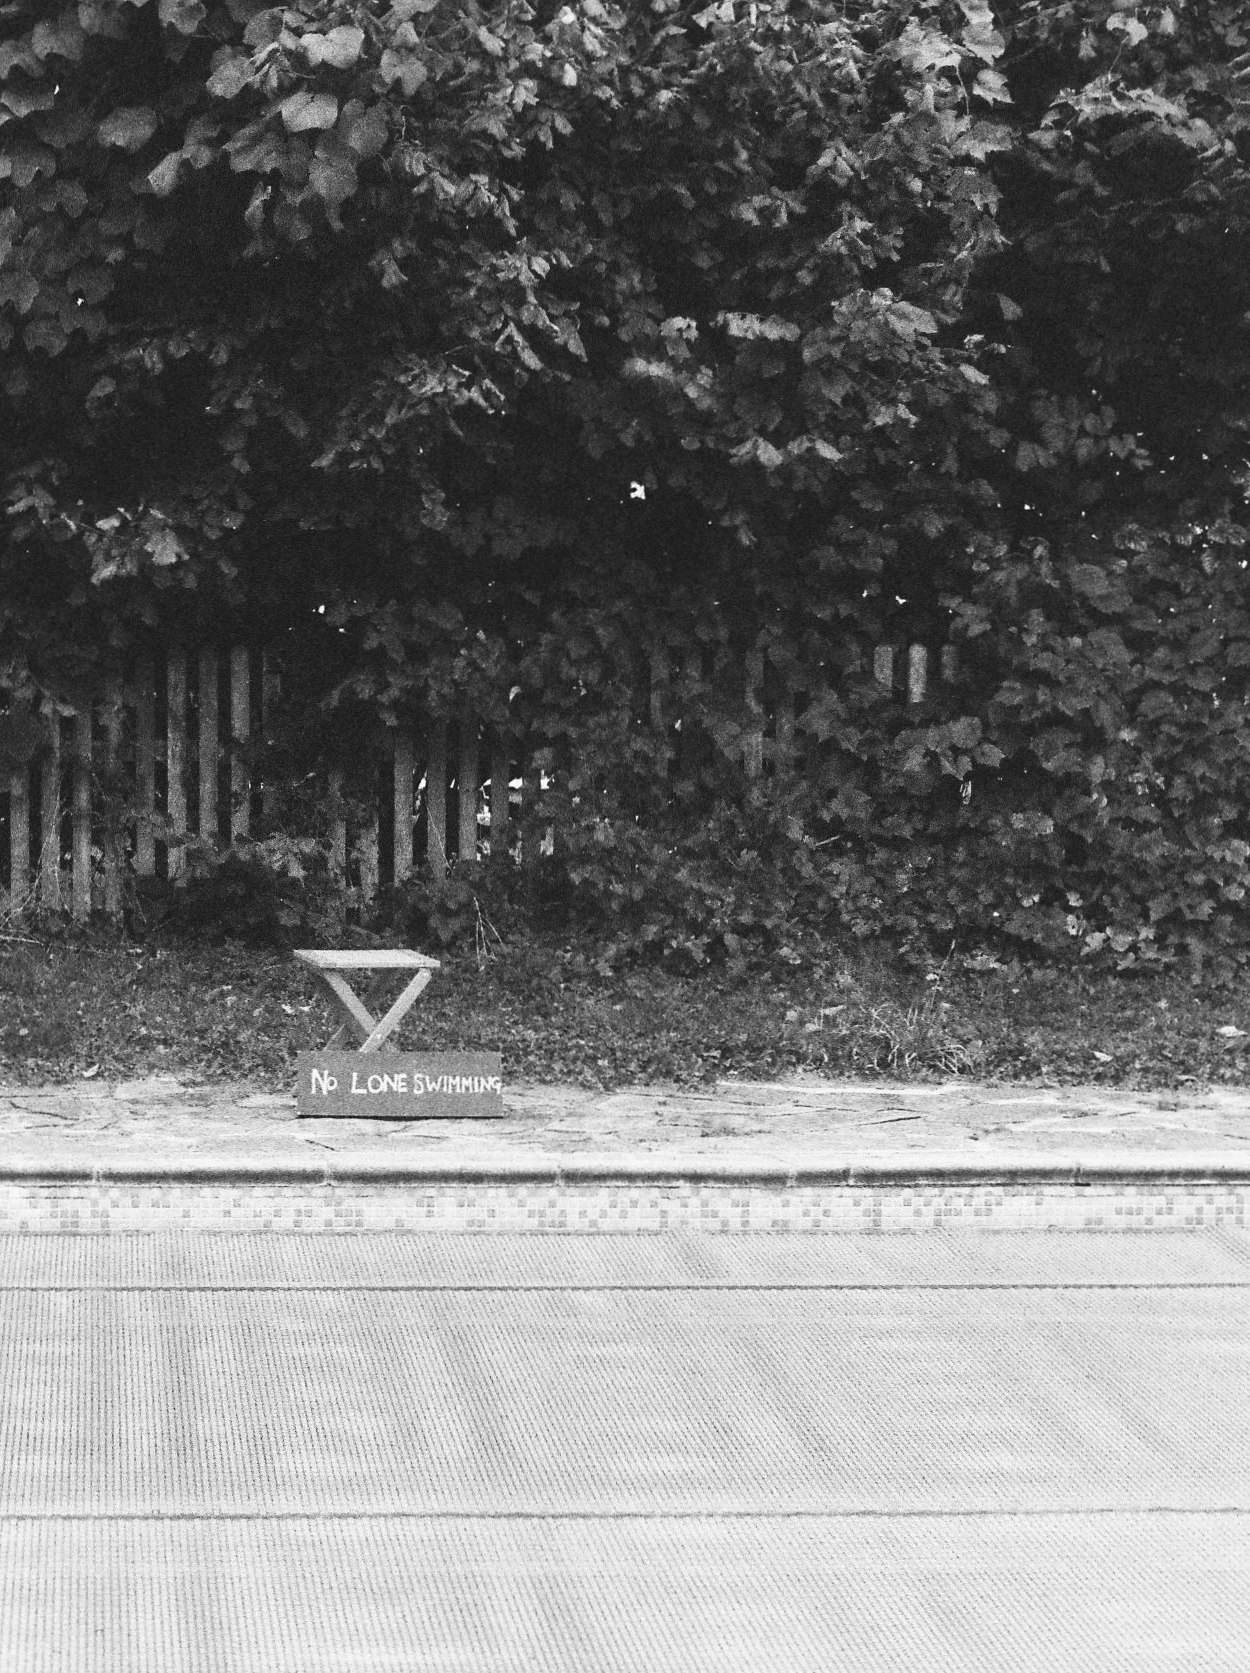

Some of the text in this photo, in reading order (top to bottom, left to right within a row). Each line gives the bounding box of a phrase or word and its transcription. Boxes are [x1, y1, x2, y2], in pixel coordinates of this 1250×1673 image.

[311, 1068, 502, 1095] No LONE SWIMMING
